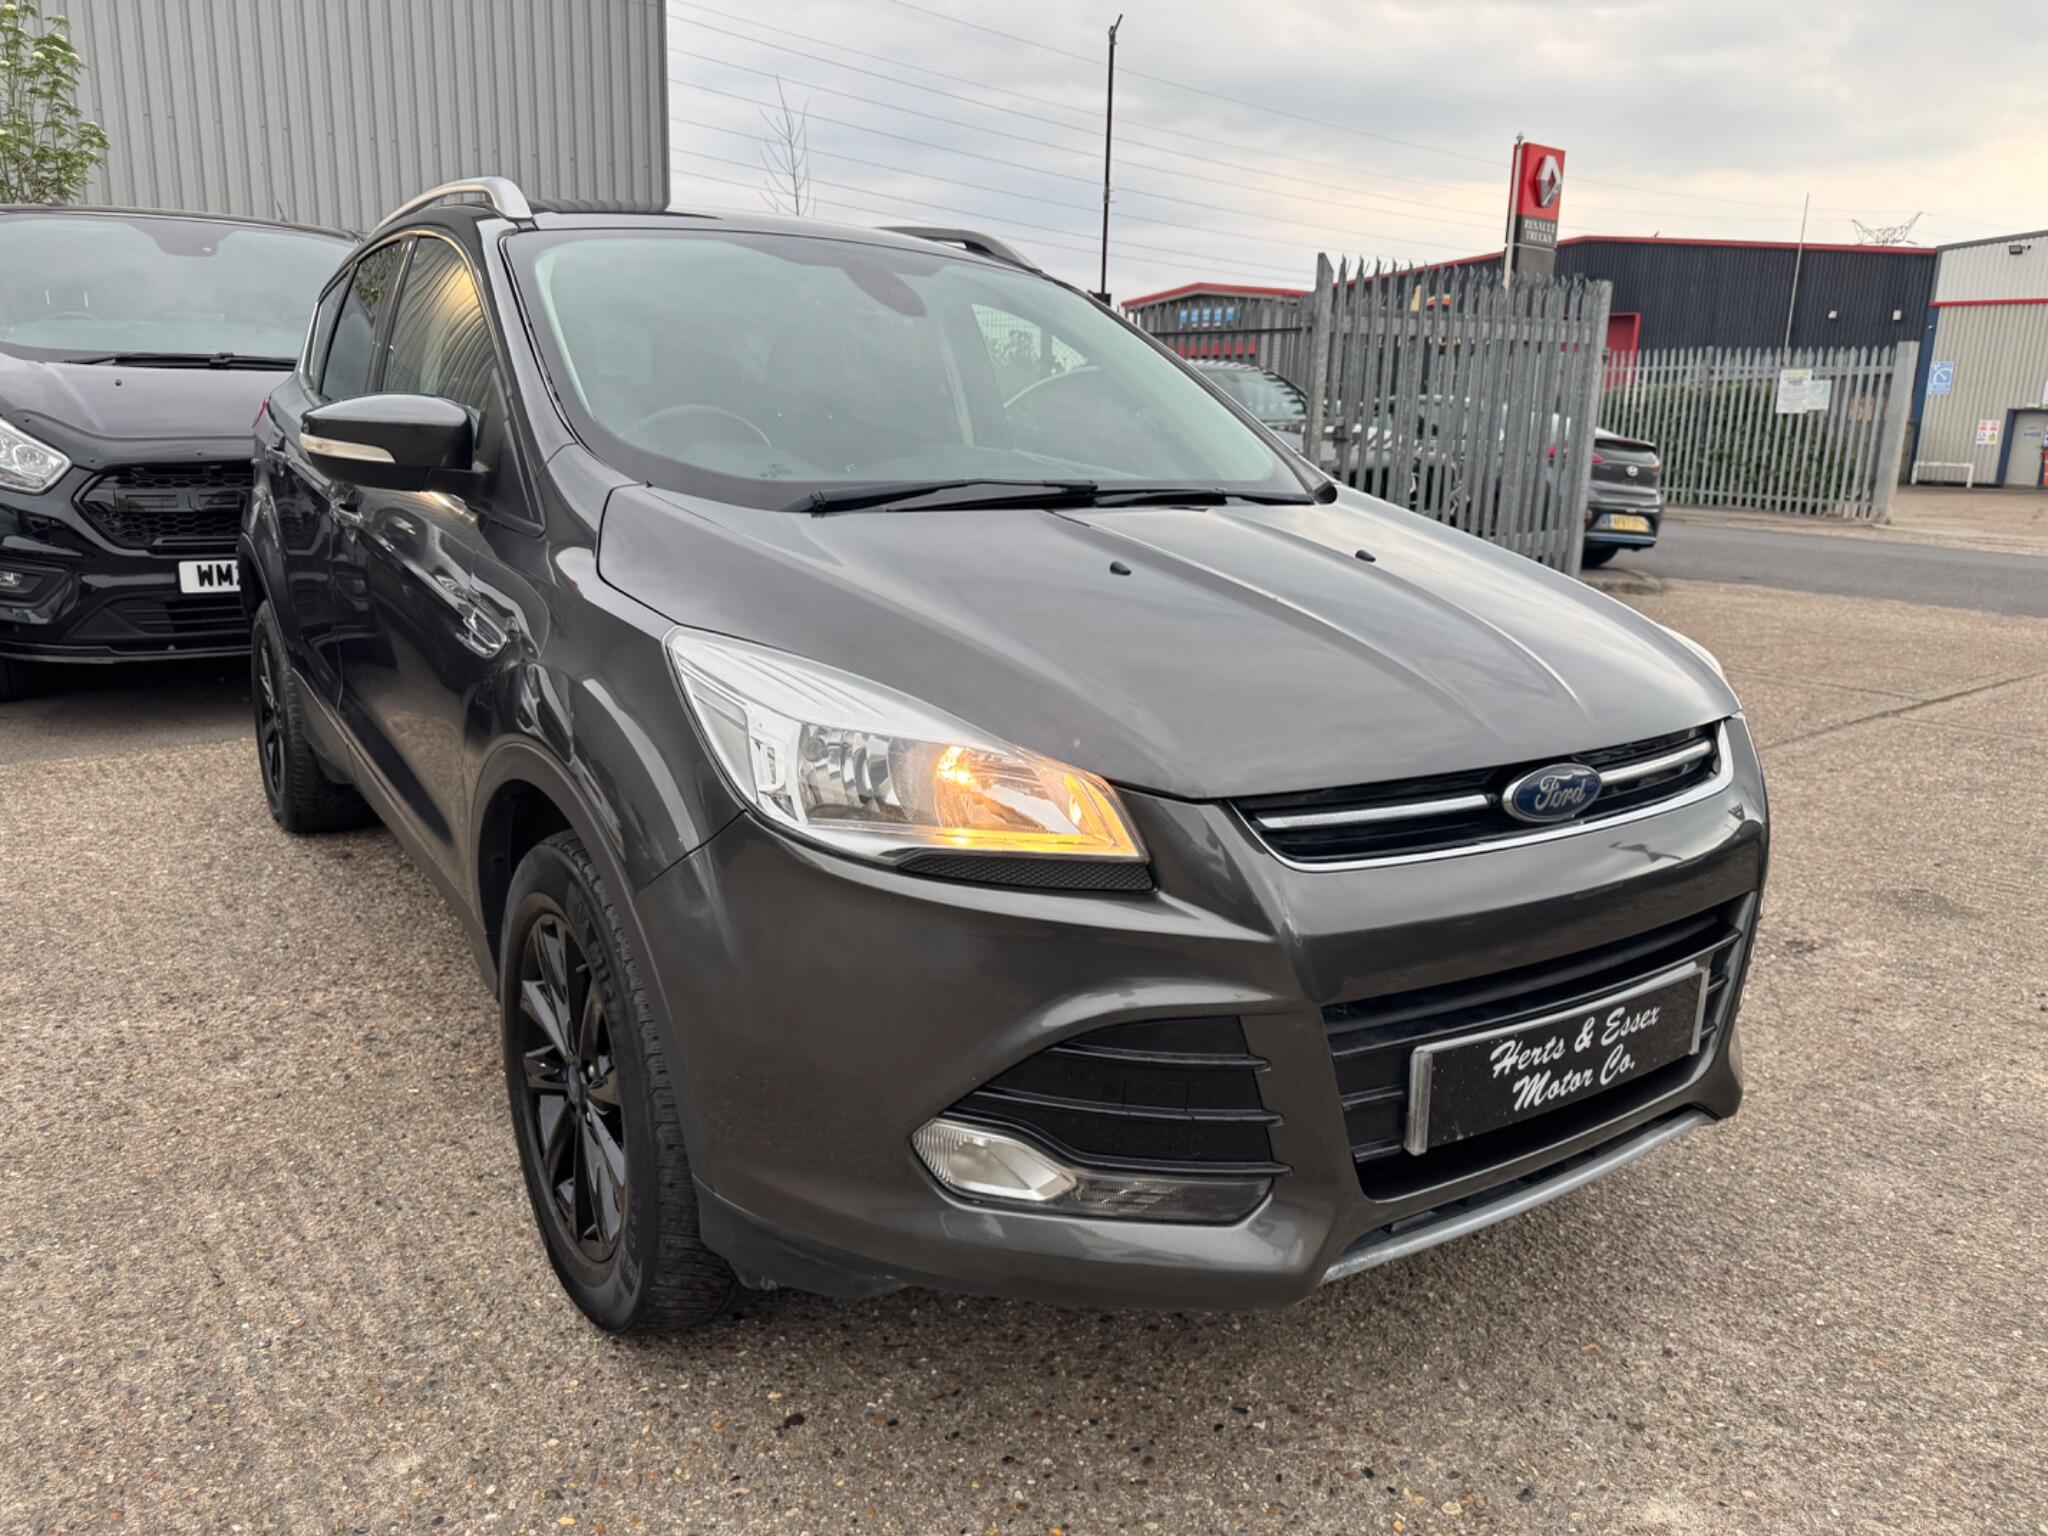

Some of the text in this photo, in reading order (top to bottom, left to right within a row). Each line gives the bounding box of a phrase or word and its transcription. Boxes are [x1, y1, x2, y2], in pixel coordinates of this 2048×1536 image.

[1525, 230, 1553, 243] TRUCKS
[1534, 770, 1589, 811] Ford
[1489, 1005, 1661, 1079] Herts & Essex
[1512, 1043, 1636, 1112] Motor Co.
